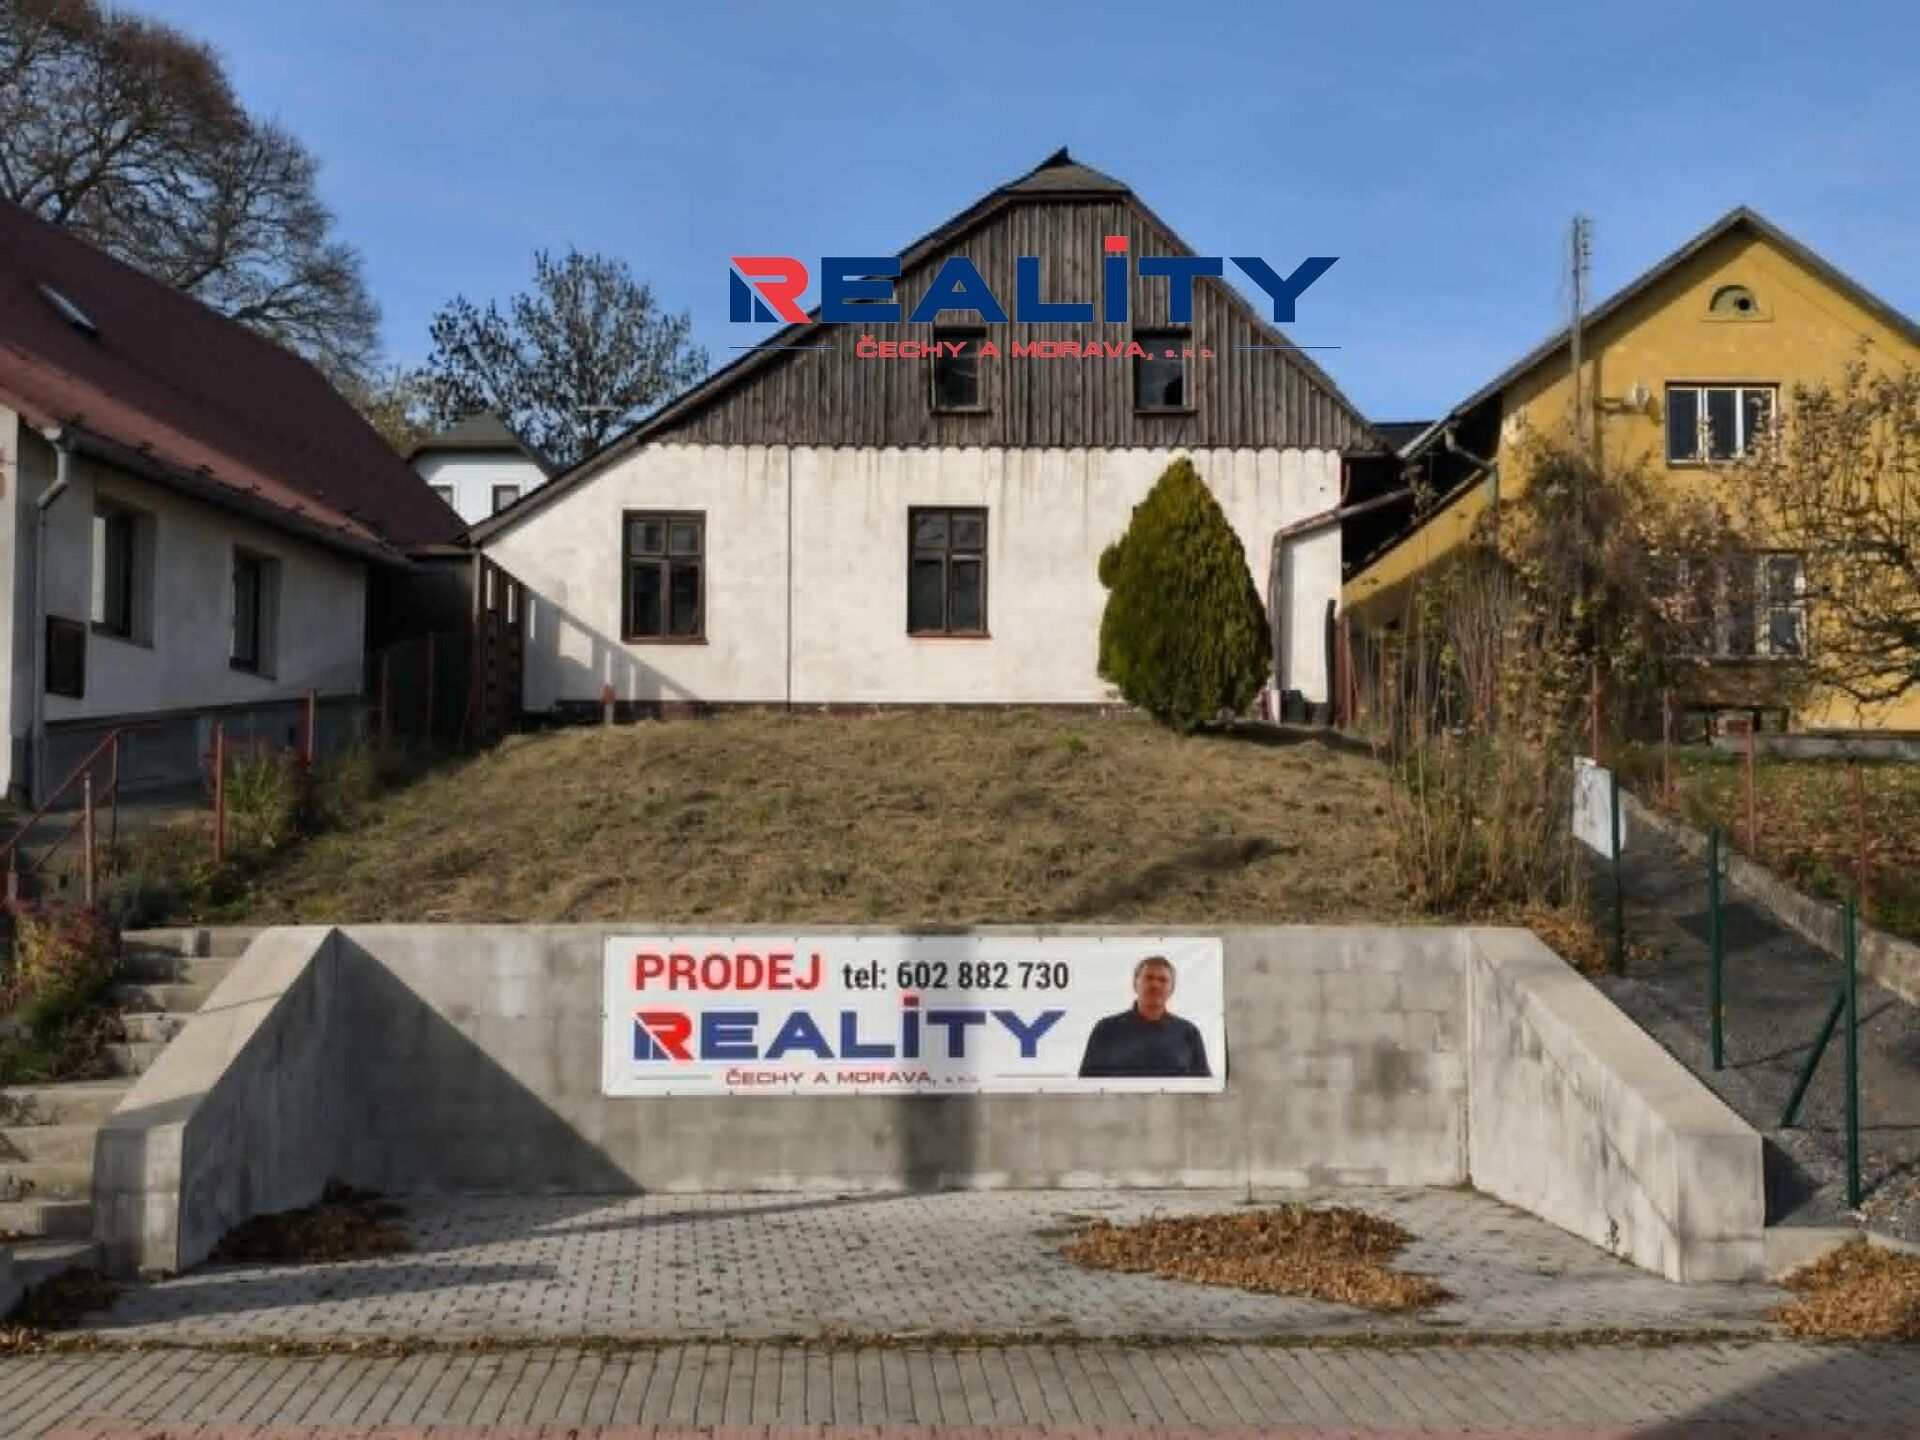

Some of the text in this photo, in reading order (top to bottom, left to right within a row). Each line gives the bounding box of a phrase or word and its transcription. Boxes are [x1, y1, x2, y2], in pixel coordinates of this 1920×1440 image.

[635, 953, 1070, 991] PRODEJ tel: 602 882 730
[725, 1067, 803, 1086] ČECHY
[813, 1071, 829, 1085] A
